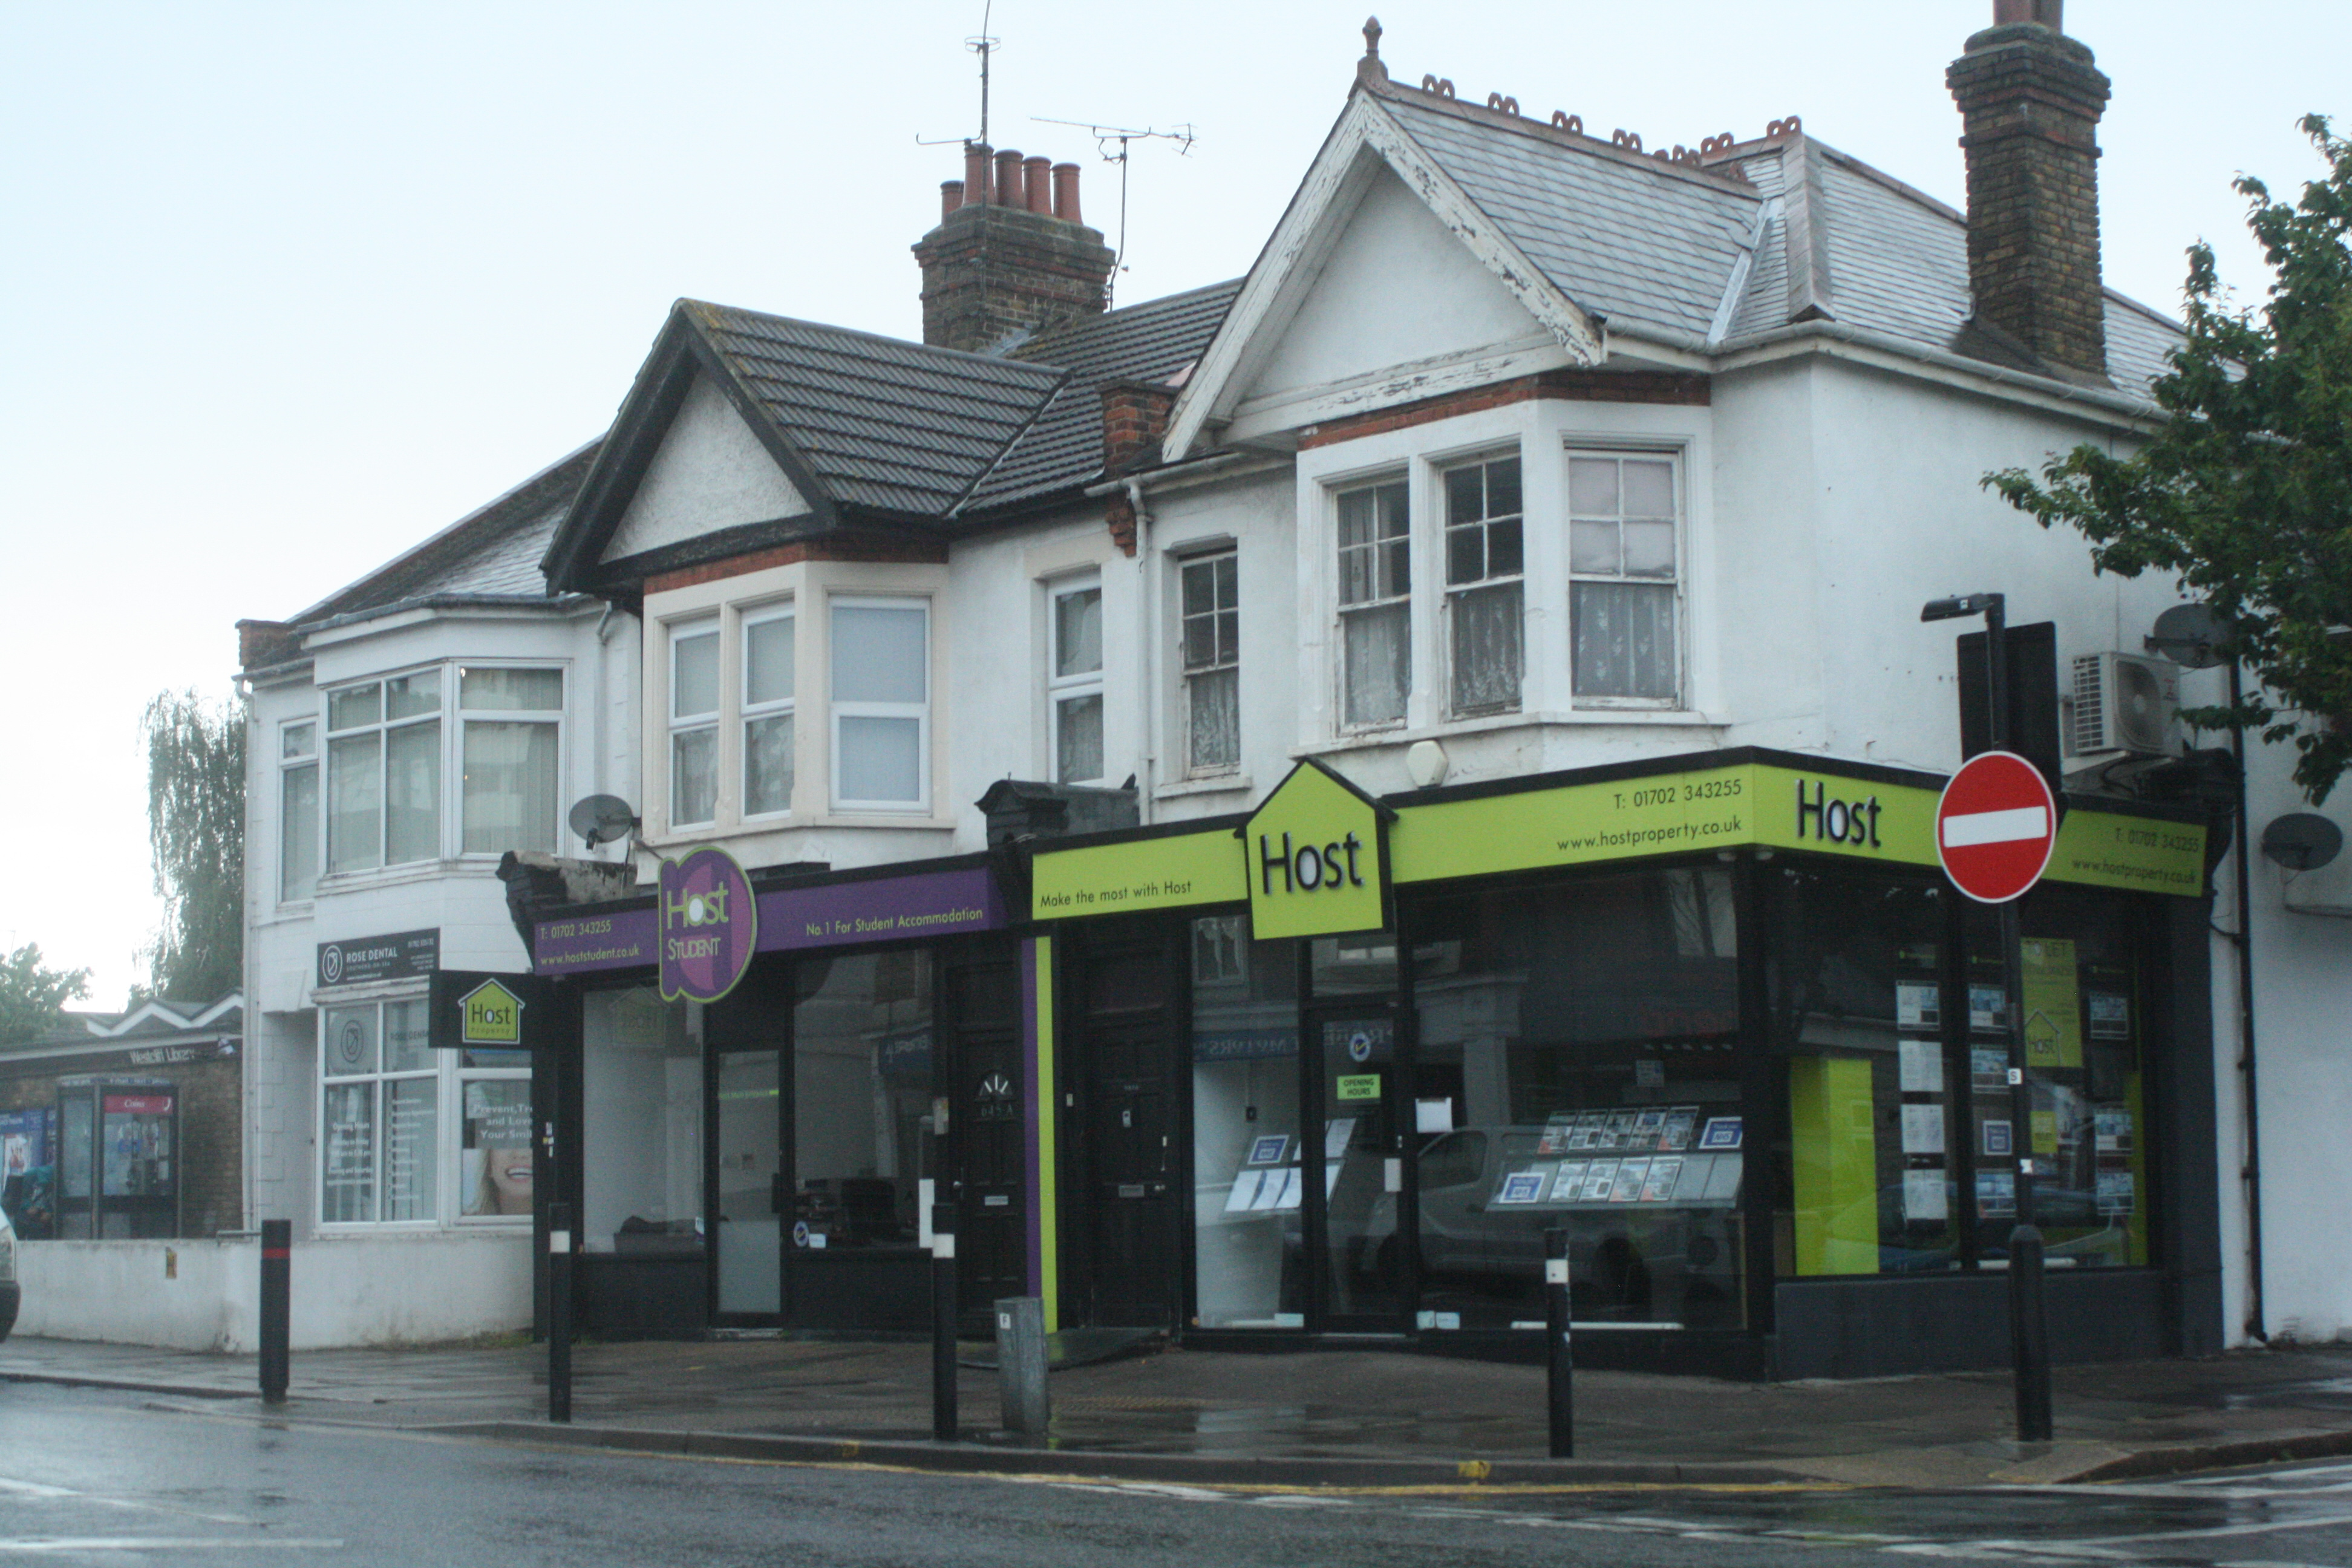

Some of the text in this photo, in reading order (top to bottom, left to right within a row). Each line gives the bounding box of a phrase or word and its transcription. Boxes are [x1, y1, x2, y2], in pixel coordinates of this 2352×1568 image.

[1614, 779, 1741, 809] T: 01702 343255
[1795, 778, 1882, 848] Host
[1557, 815, 1741, 850] www.hostproperty.co.uk
[1259, 831, 1365, 895] Host
[667, 881, 729, 930] Host
[1040, 879, 1191, 908] Make the most with Host
[551, 924, 575, 939] 01702
[579, 920, 612, 935] 343255
[835, 920, 851, 935] For
[855, 916, 893, 933] Student
[898, 907, 984, 928] Accommodation
[347, 947, 398, 964] ROSE DENTAL
[541, 943, 640, 965] www.hoststudent.co.uk
[472, 1003, 511, 1024] Host
[1344, 1078, 1374, 1087] OPENING
[1347, 1088, 1371, 1096] HOURS
[480, 1129, 506, 1138] Your
